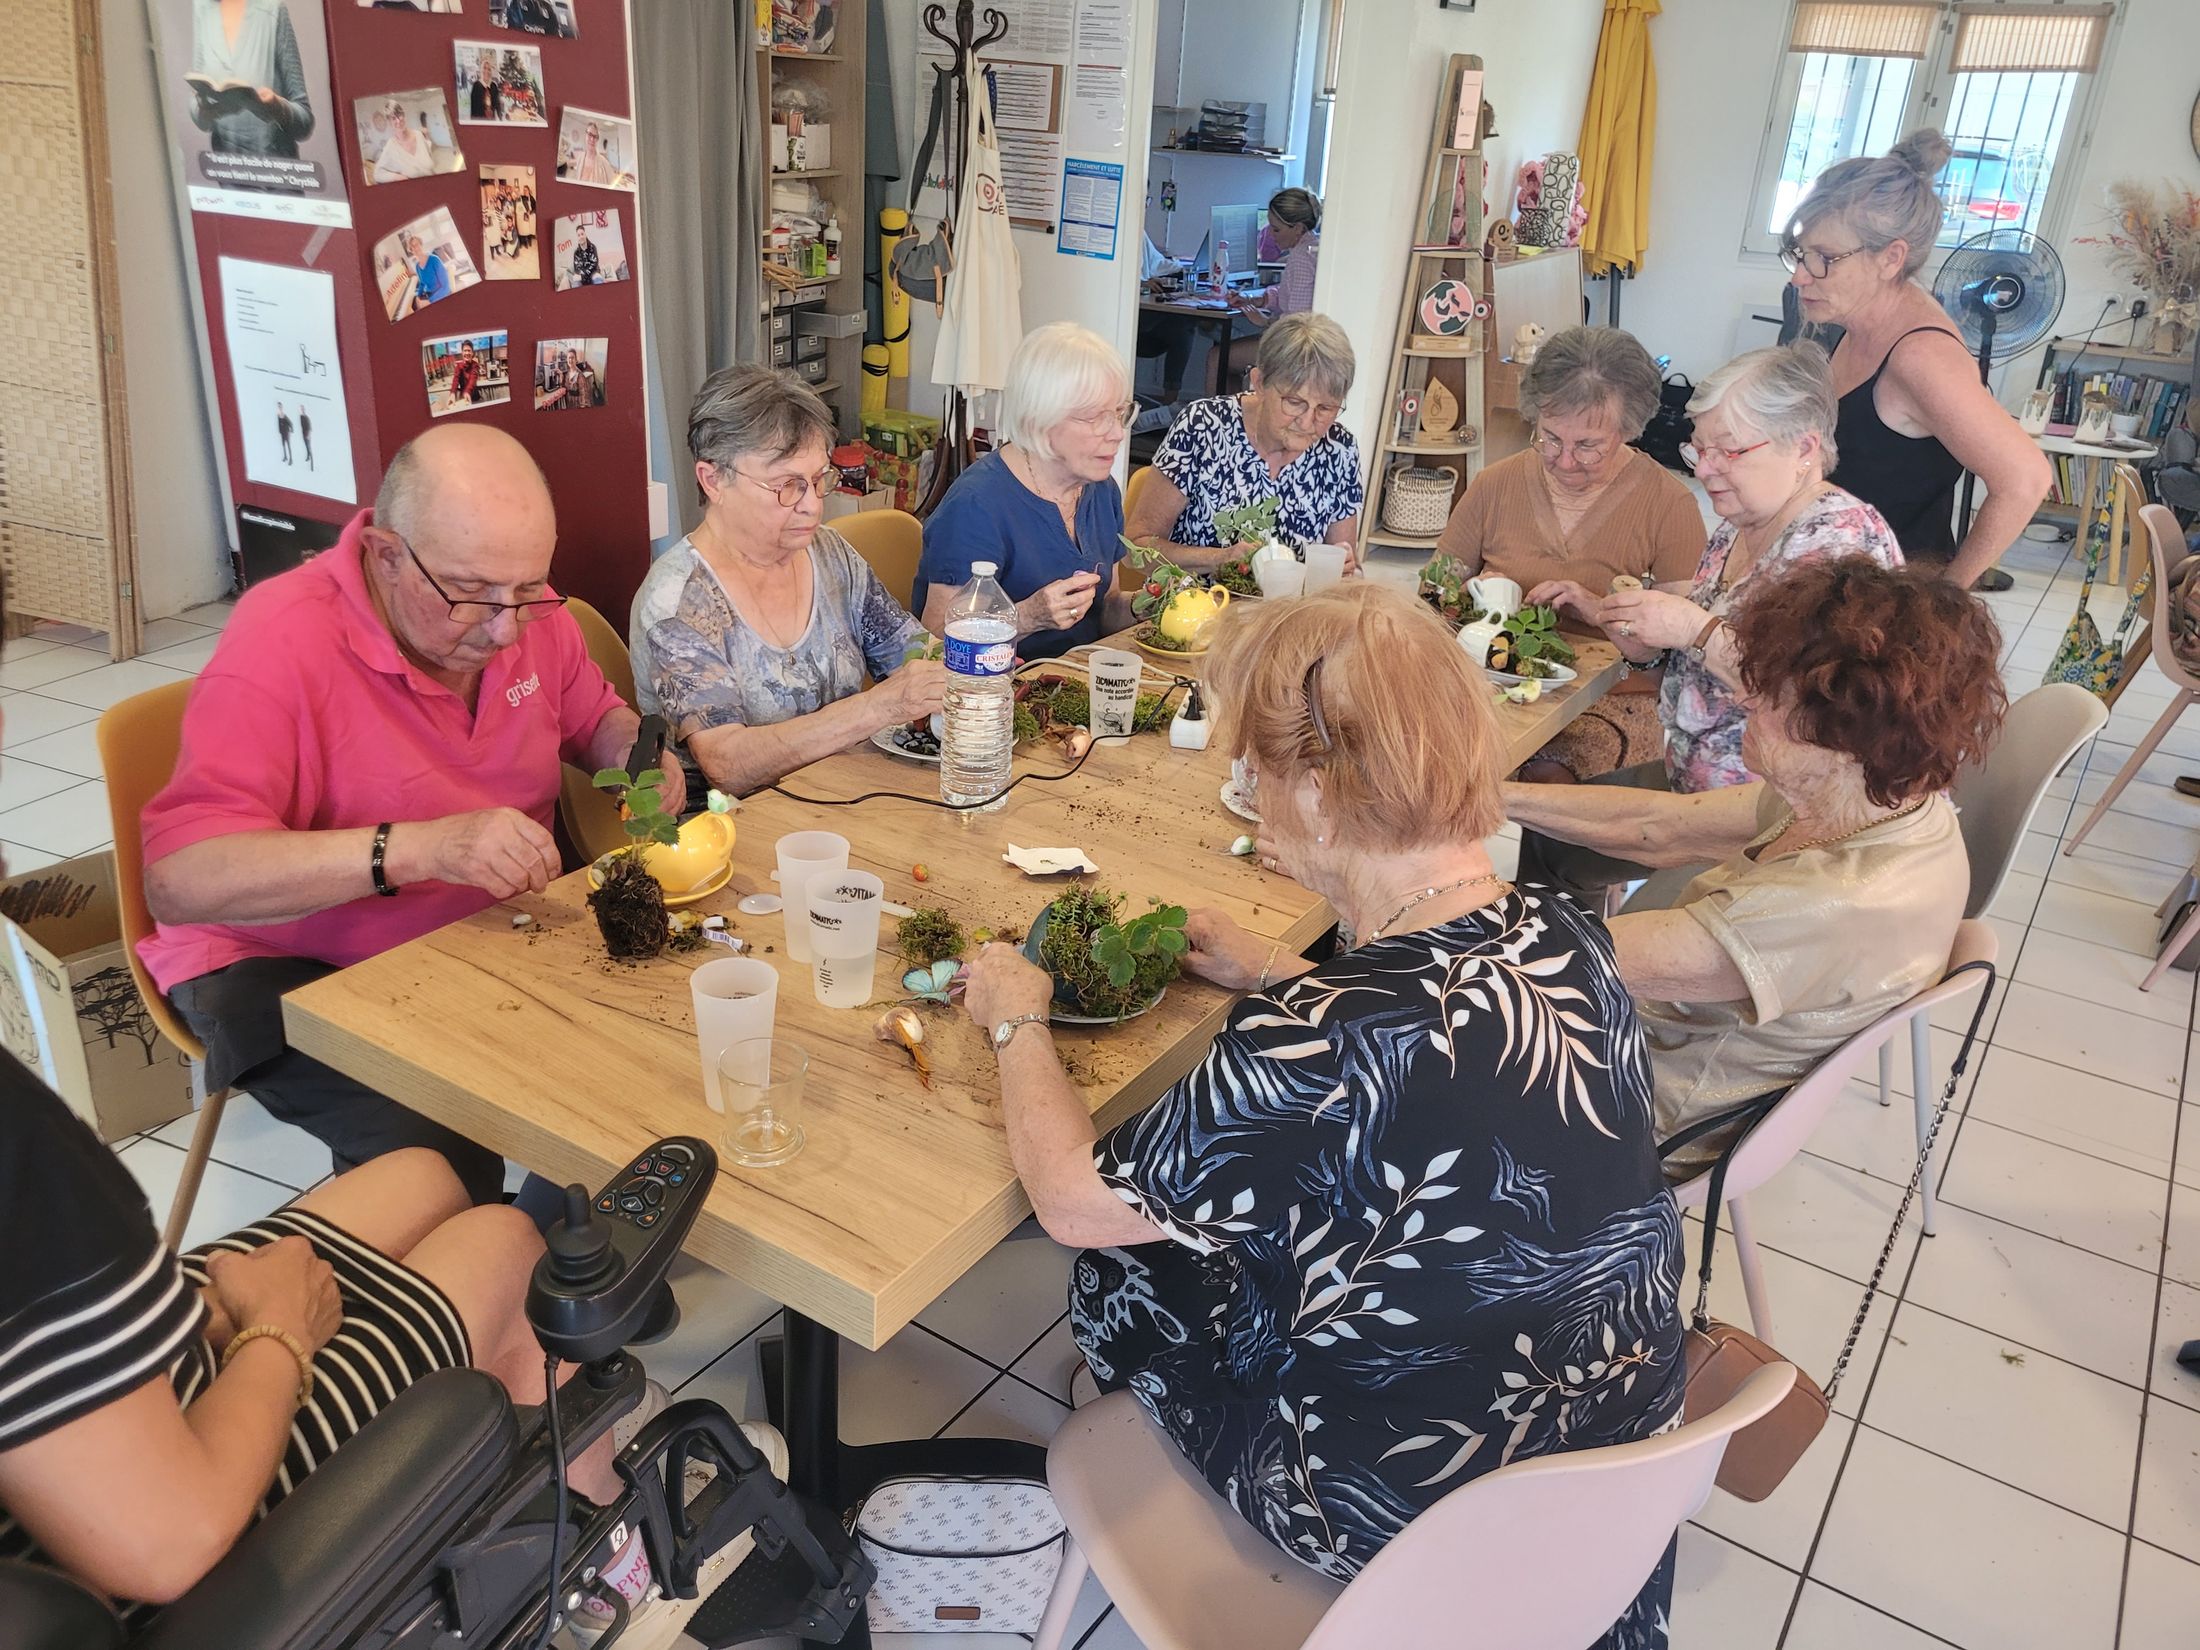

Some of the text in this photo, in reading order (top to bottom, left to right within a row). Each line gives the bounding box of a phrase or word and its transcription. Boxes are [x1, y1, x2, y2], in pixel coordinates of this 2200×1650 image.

[263, 158, 273, 168] de
[556, 239, 573, 253] Tom
[951, 640, 972, 654] DOYE
